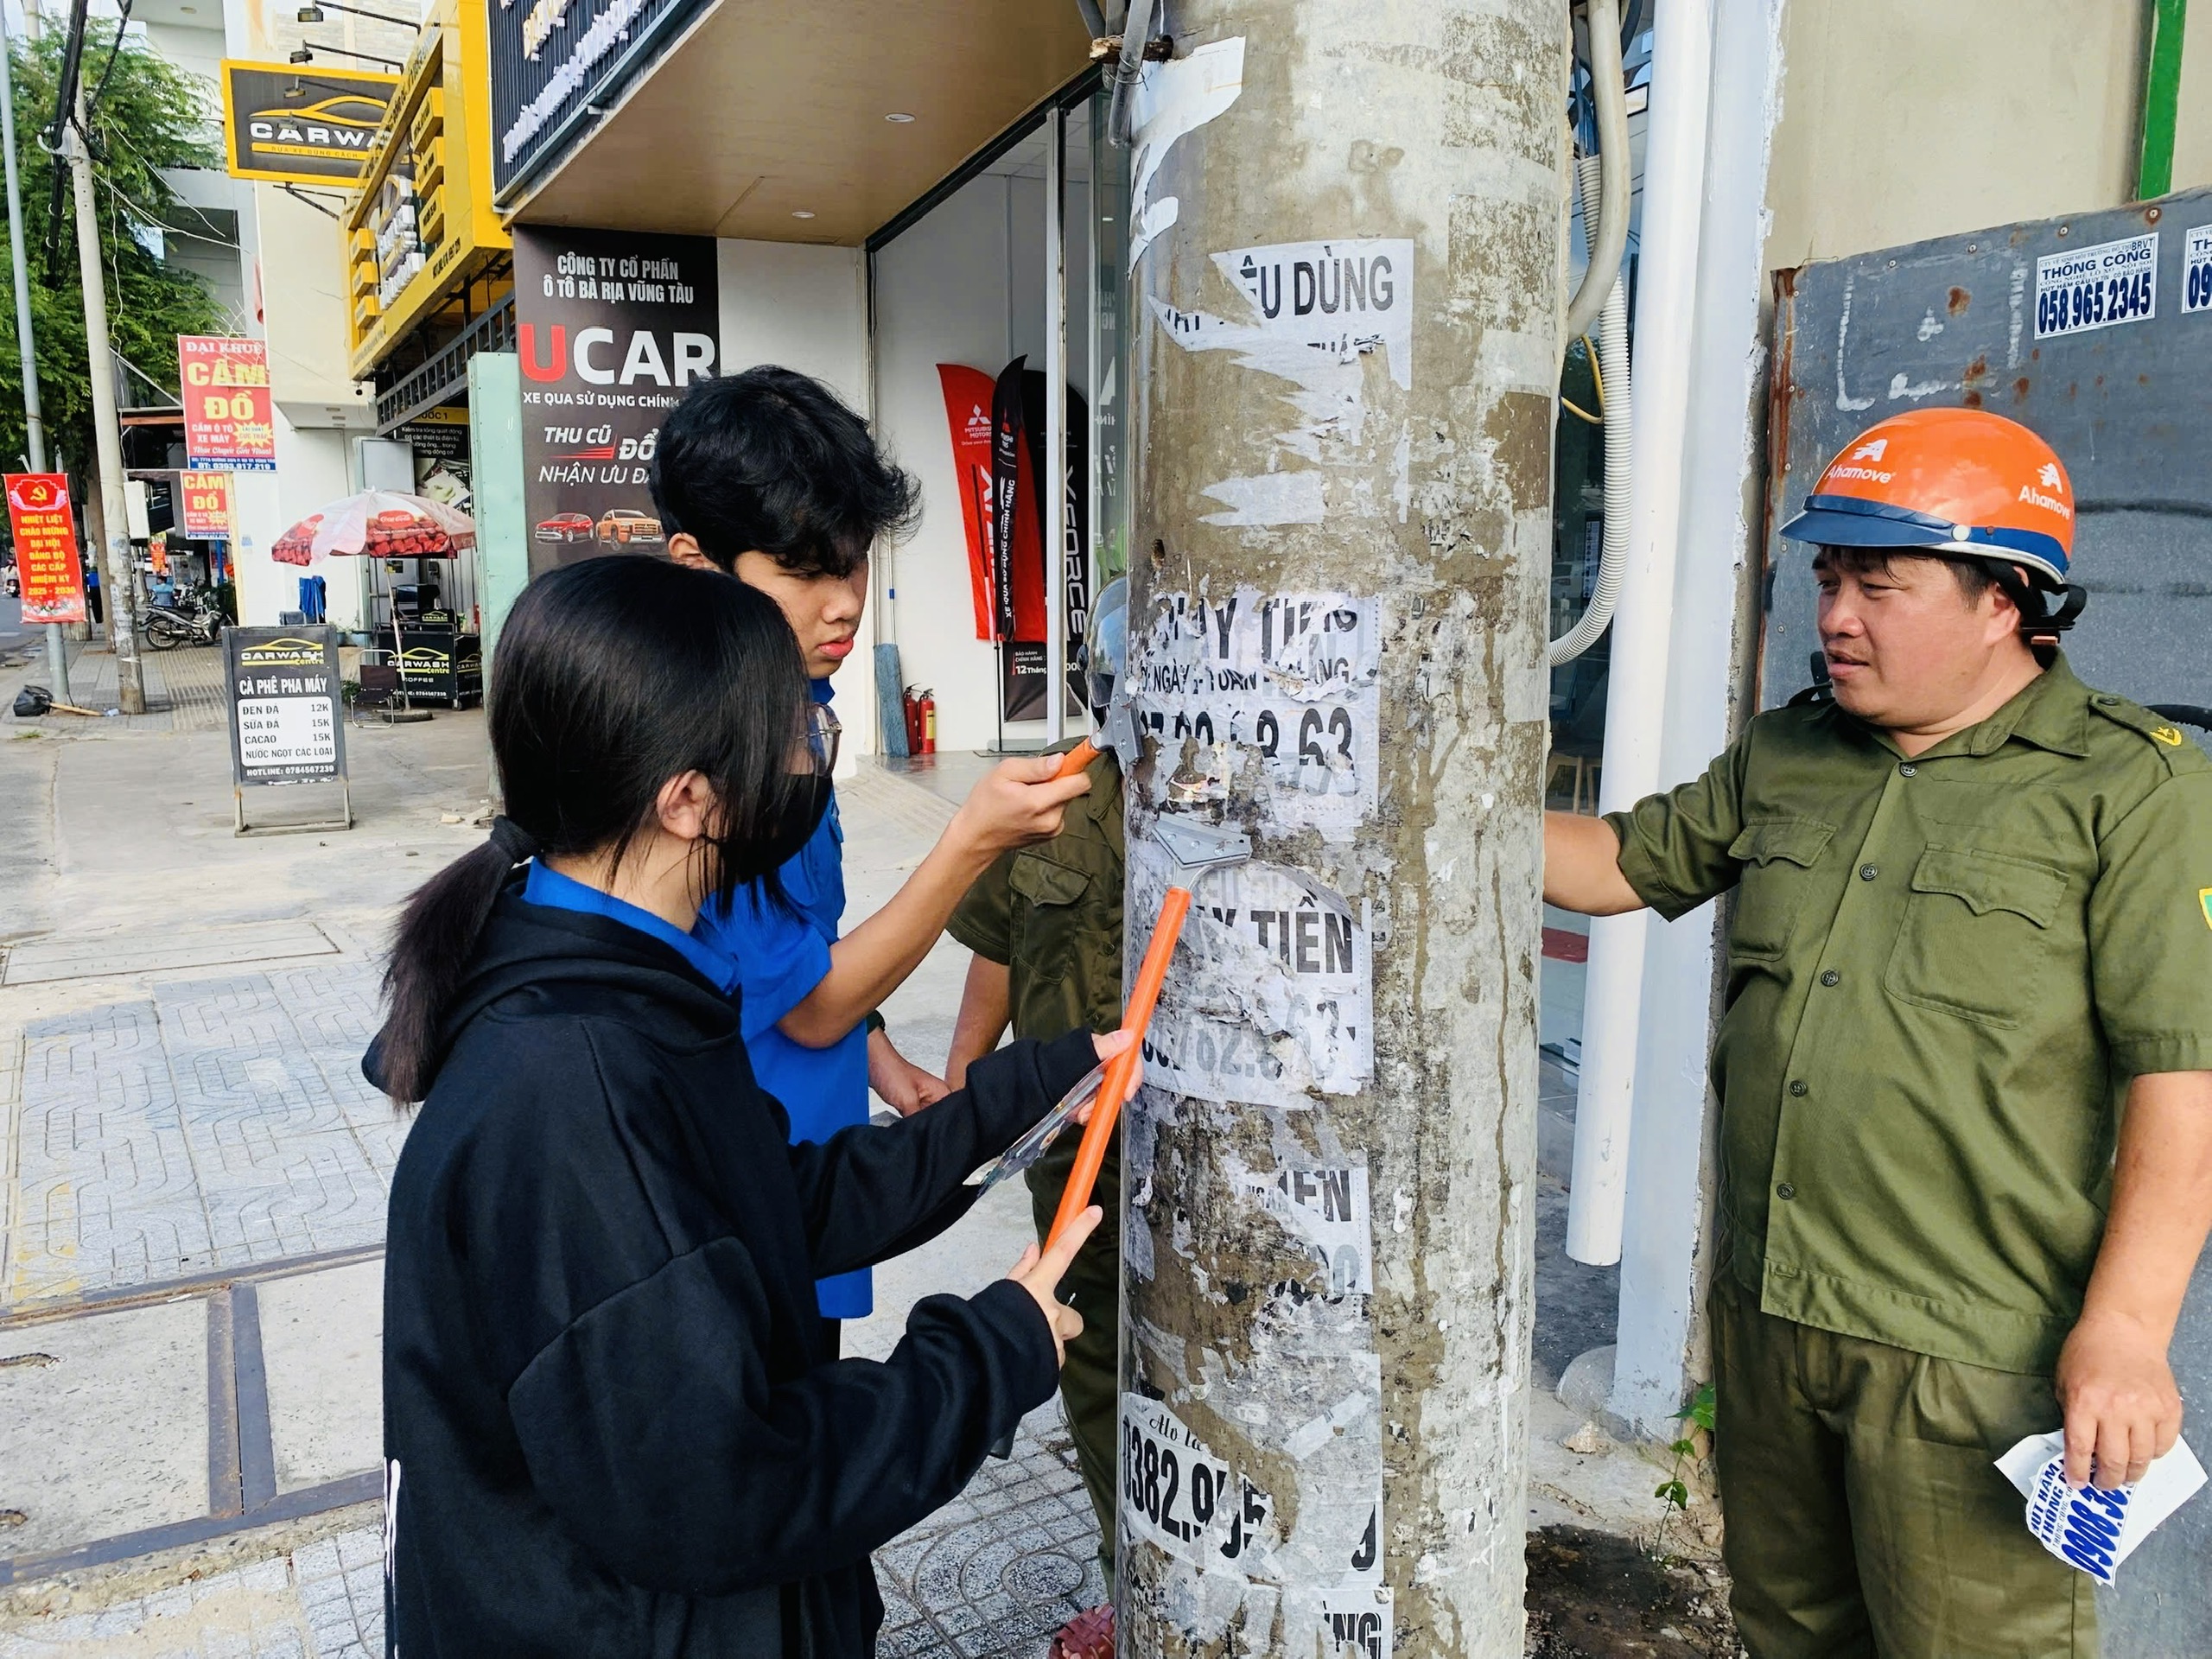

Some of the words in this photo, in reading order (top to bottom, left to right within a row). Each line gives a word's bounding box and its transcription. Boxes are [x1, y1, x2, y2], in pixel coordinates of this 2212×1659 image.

[2132, 238, 2154, 251] BRVT
[557, 251, 595, 276] CÔNG
[599, 257, 615, 276] TY
[2042, 260, 2096, 280] THÔNG
[2103, 248, 2151, 267] CỐNG
[543, 274, 554, 297] Ô
[556, 276, 575, 298] TÔ
[579, 277, 598, 300] BÀ
[601, 282, 625, 303] RỊA
[628, 280, 664, 302] VŨNG
[668, 282, 694, 303] TÀU
[1294, 245, 1394, 316] DÙNG
[2038, 271, 2152, 334] 058.965.2345
[186, 341, 215, 355] ĐẠI
[519, 323, 716, 388] UCAR
[204, 390, 255, 420] ĐỒ
[524, 392, 541, 404] XE
[544, 393, 574, 406] QUA
[576, 391, 594, 405] SỬ
[598, 394, 635, 409] DỤNG
[197, 434, 208, 443] XE
[543, 426, 582, 444] THU
[586, 424, 612, 444] CŨ
[619, 428, 660, 461] ĐỔ
[538, 461, 597, 486] NHẬN
[601, 464, 627, 484] ƯU
[1827, 464, 1892, 484] Ahamove
[21, 515, 43, 525] NHIỆT
[46, 514, 63, 524] LIỆT
[20, 526, 41, 537] CHÀO
[42, 525, 69, 536] MỪNG
[30, 538, 43, 550] ĐẠI
[45, 538, 60, 549] HỘI
[31, 563, 47, 572] CÁC
[30, 575, 57, 585] NHIỆM
[241, 651, 324, 661] CARWASH
[239, 676, 255, 695] CÀ
[257, 675, 279, 695] PHÊ
[281, 677, 302, 694] PHA
[304, 673, 327, 693] MÁY
[242, 705, 263, 715] ĐEN
[266, 702, 280, 715] ĐÁ
[311, 703, 329, 713] 12K
[244, 718, 264, 730] SỮA
[266, 718, 280, 729] ĐÁ
[312, 718, 330, 728] 15K
[245, 734, 276, 745] CACAO
[313, 733, 331, 741] 15K
[245, 748, 269, 760] NƯỚC
[271, 748, 292, 760] NGỌT
[296, 747, 311, 757] CÁC
[315, 747, 333, 758] LOẠI
[246, 768, 283, 777] HOTLINE:
[1149, 1414, 1179, 1442] Alo
[2041, 1486, 2064, 1543] THÔNG
